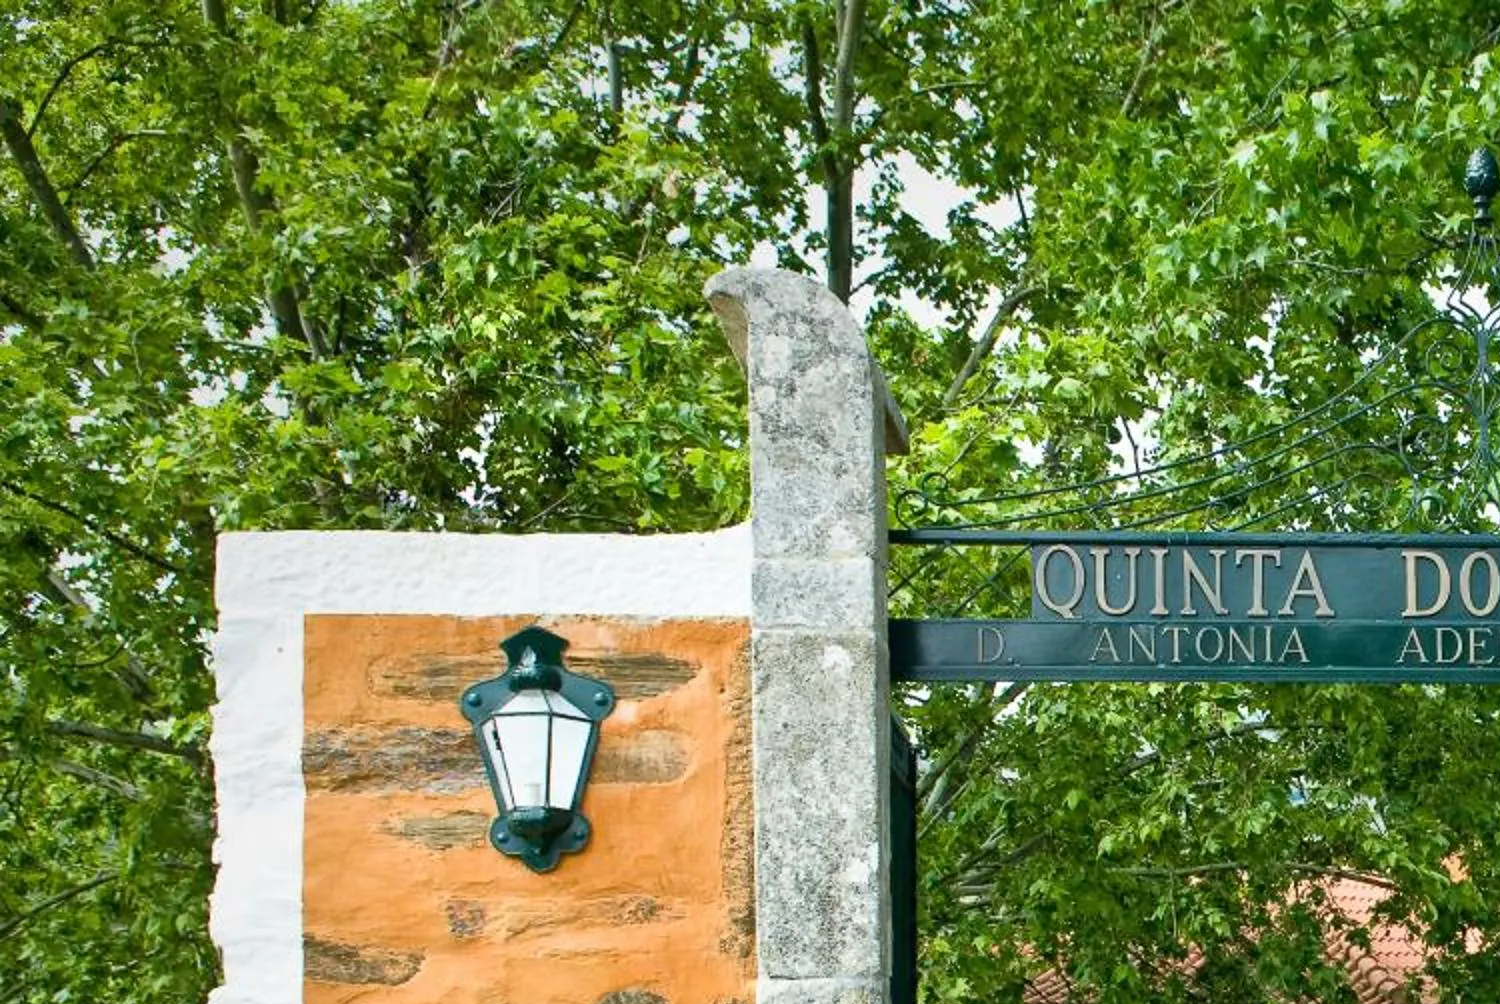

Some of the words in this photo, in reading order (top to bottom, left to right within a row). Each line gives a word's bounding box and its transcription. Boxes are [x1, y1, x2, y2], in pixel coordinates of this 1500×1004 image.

[1034, 543, 1335, 618] QUINTA
[1400, 549, 1500, 619] DO
[1088, 626, 1310, 664] ANTONIA
